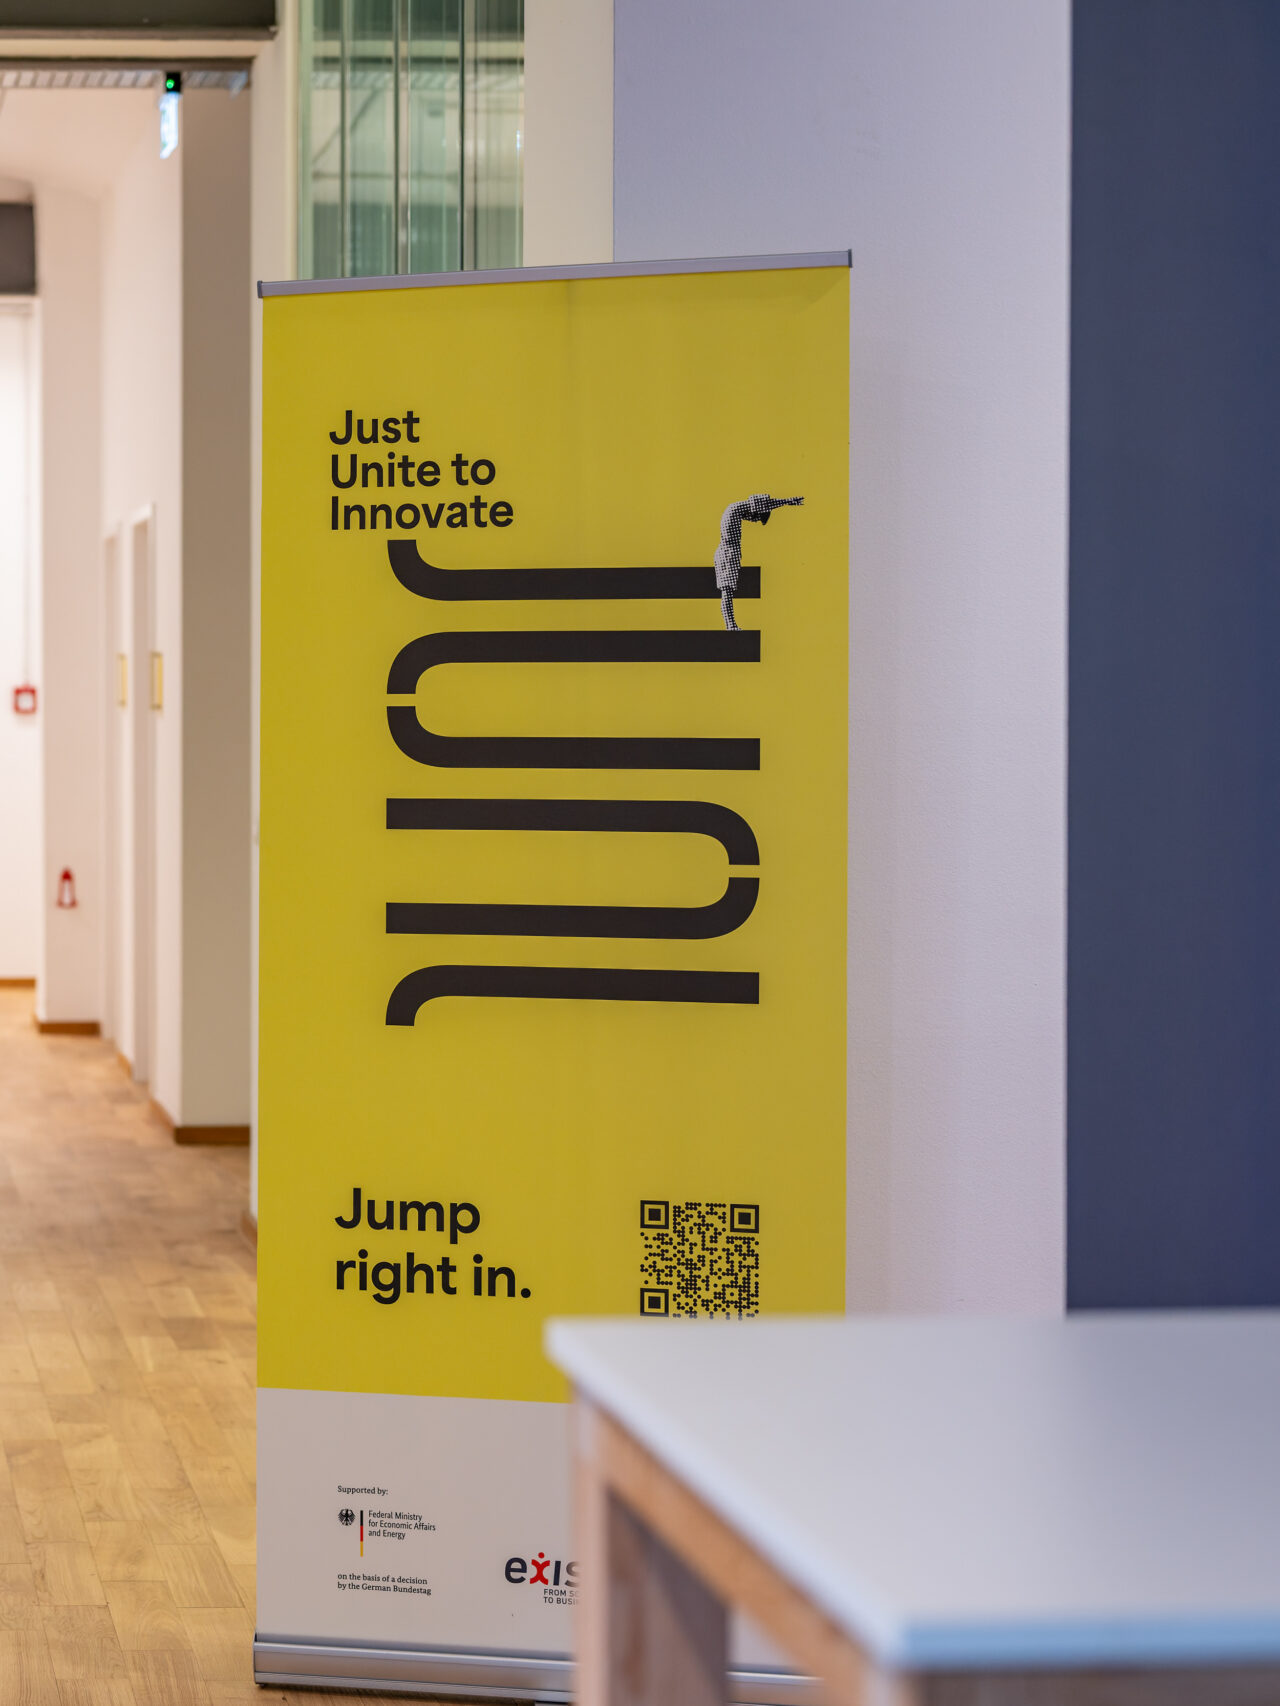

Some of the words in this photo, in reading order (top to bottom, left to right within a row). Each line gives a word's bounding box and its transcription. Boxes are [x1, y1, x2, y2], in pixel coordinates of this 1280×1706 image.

[329, 410, 420, 446] Just
[330, 451, 441, 489] Unite
[451, 452, 497, 487] to
[330, 495, 514, 531] Innovate
[334, 1187, 481, 1245] Jump
[335, 1248, 457, 1305] right
[472, 1253, 532, 1299] in.
[337, 1485, 376, 1495] Supported
[377, 1487, 388, 1496] by:
[368, 1510, 393, 1519] Federal
[395, 1512, 422, 1522] Ministry
[368, 1519, 378, 1527] for
[379, 1520, 412, 1530] Economic
[413, 1523, 436, 1531] Affairs
[382, 1530, 406, 1540] Energy
[349, 1573, 361, 1581] the
[362, 1574, 380, 1582] basis
[381, 1575, 390, 1583] of
[396, 1576, 428, 1585] decision
[337, 1582, 347, 1590] by
[361, 1583, 392, 1592] German
[393, 1585, 432, 1596] Bundestag
[543, 1589, 567, 1597] FROM
[543, 1596, 554, 1604] TO
